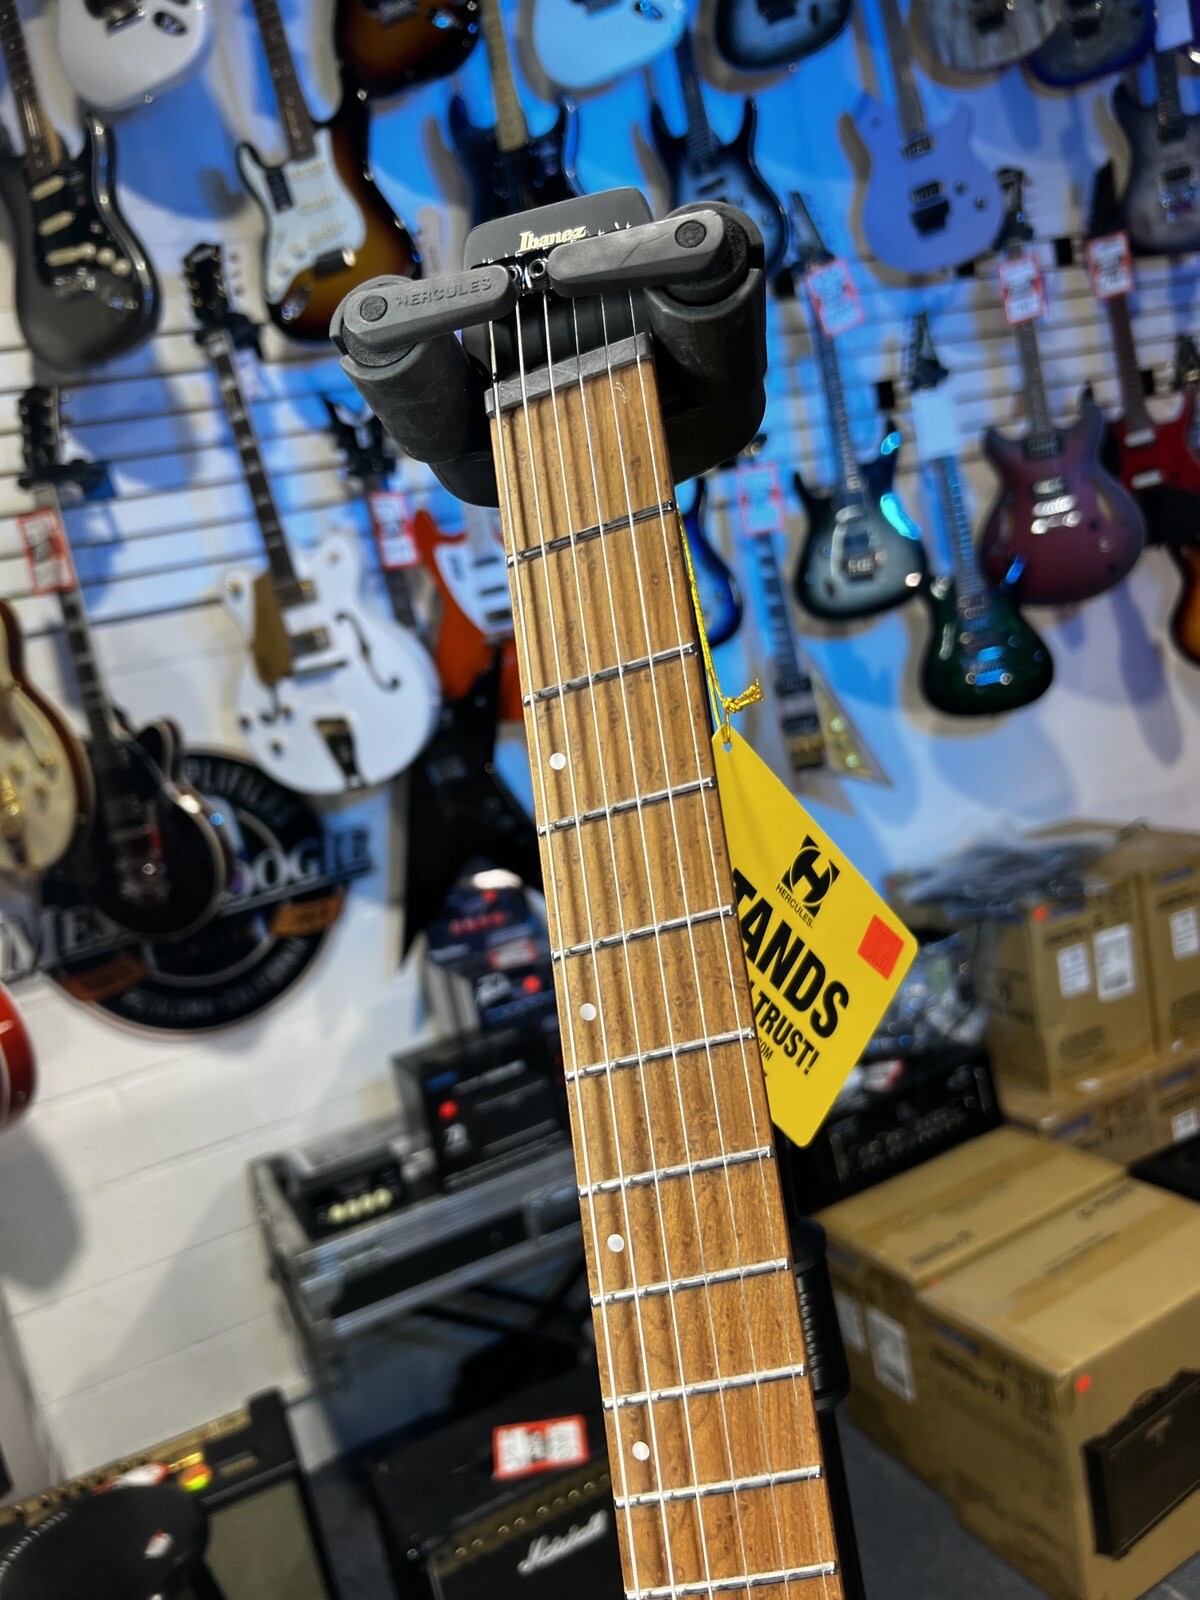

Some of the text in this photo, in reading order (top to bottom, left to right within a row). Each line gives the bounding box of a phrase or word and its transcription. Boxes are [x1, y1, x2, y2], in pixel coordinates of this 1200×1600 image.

[517, 226, 587, 253] Ibanez
[396, 278, 492, 306] HERCULES
[776, 883, 814, 929] HERCULES
[732, 867, 849, 1039] TANDS
[754, 990, 820, 1075] TRUST!
